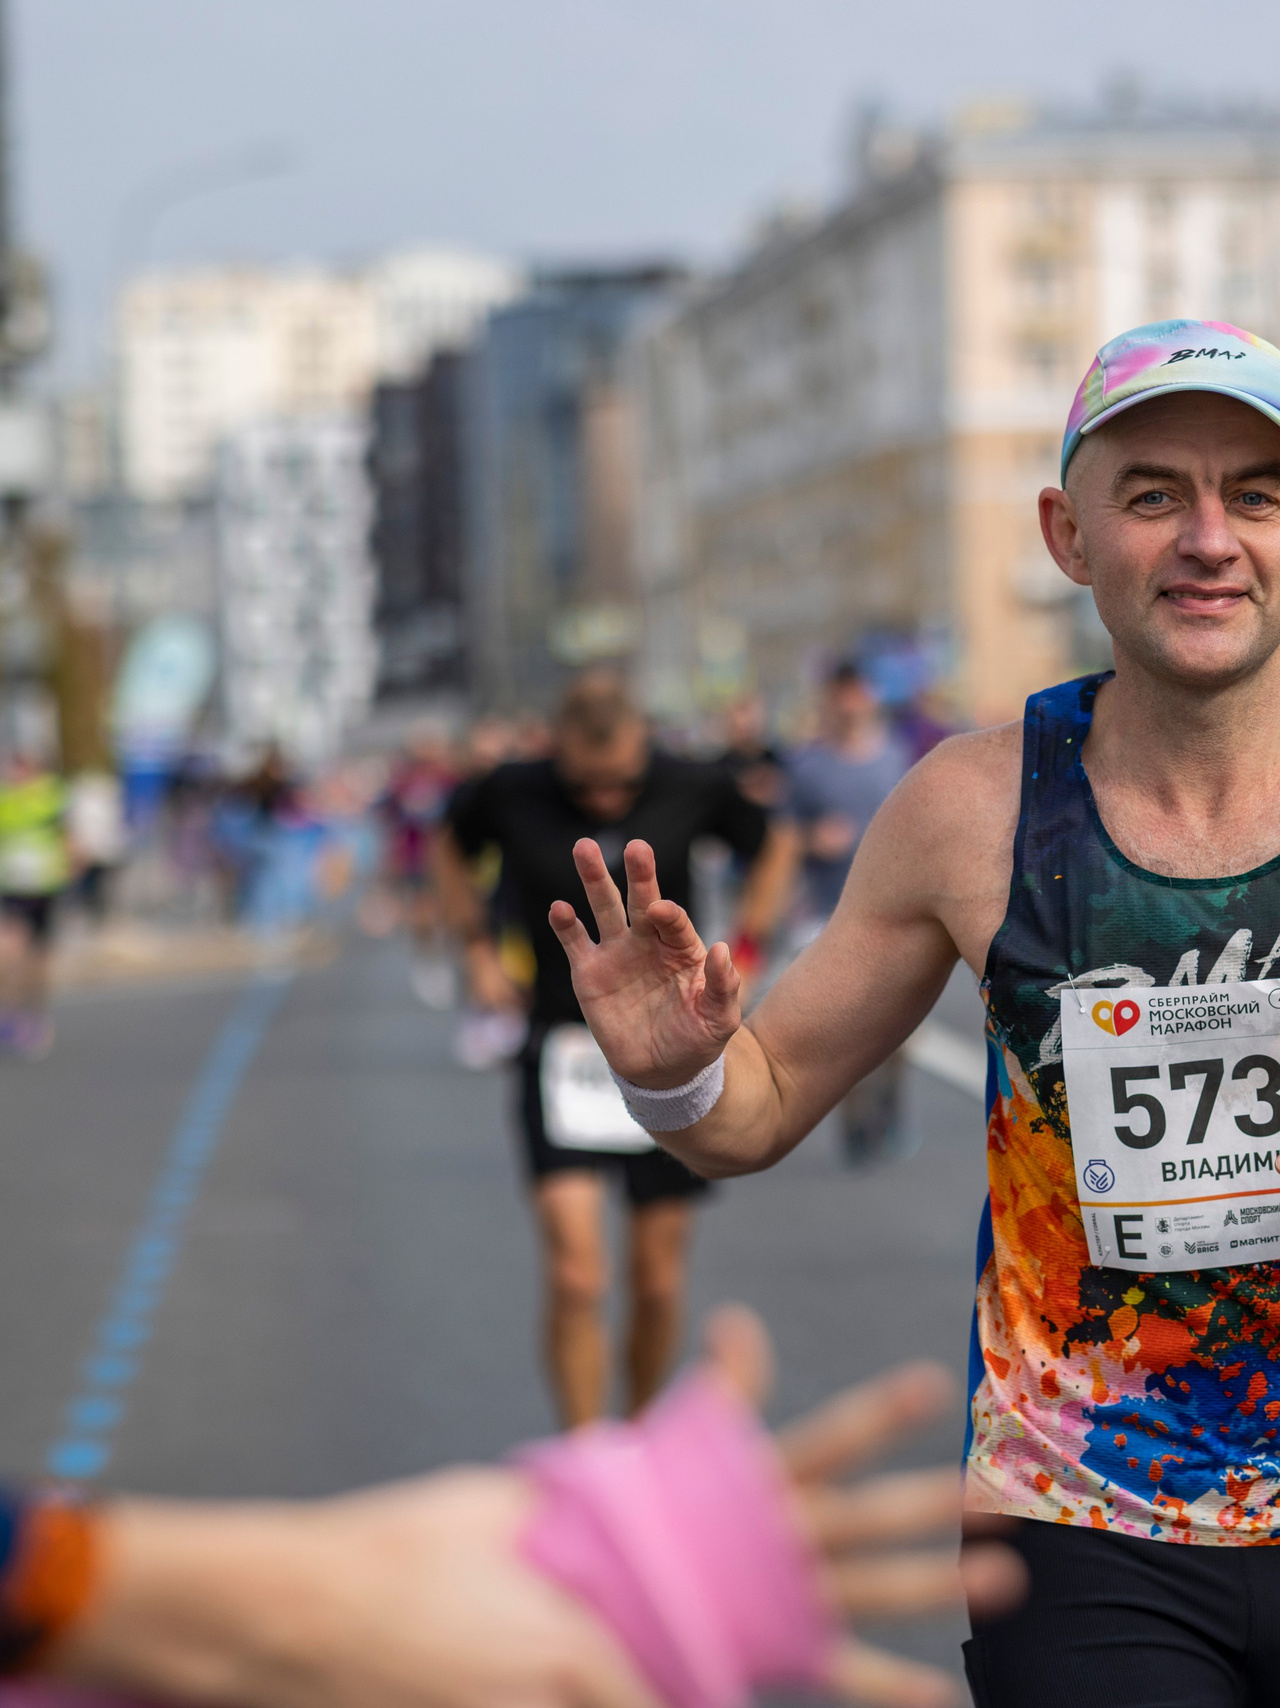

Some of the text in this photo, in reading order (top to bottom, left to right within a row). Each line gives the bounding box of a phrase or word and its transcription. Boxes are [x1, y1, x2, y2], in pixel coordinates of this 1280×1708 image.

[1148, 993, 1230, 1008] СБЕРПРАЙМ
[1149, 1001, 1260, 1022] МОСКОВСКИЙ
[1150, 1018, 1232, 1036] МАРАФОН
[1161, 1150, 1280, 1182] ВЛАДИМ
[1241, 1214, 1261, 1225] СПОРТ
[1113, 1214, 1147, 1259] E
[1239, 1234, 1280, 1247] магнит
[1197, 1245, 1220, 1254] BRICS
